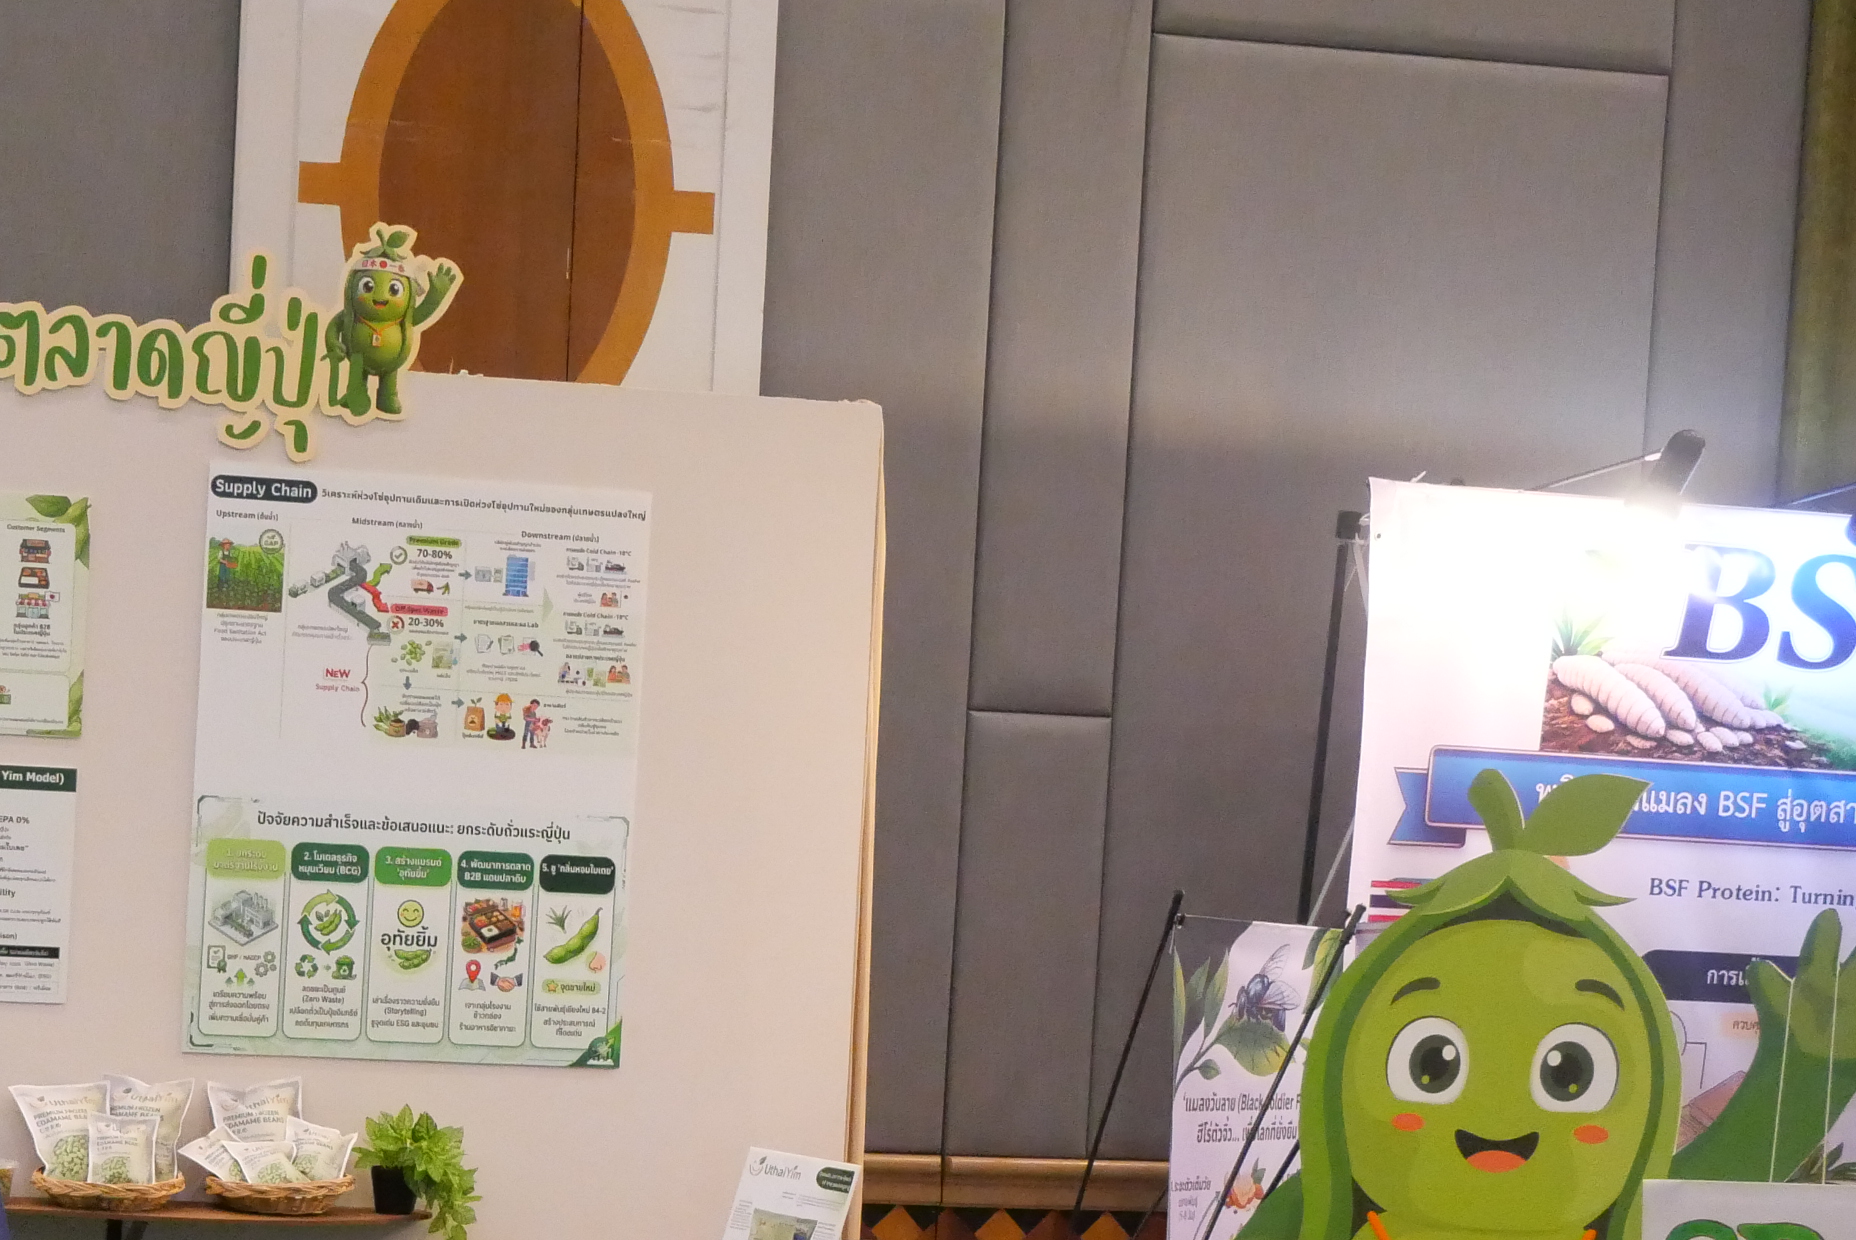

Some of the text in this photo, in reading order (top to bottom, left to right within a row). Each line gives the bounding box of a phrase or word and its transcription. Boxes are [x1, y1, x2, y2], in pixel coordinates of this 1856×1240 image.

[215, 479, 266, 498] Supply
[271, 482, 312, 499] Chain
[216, 509, 256, 520] Upstream
[351, 517, 394, 528] Midstream
[521, 530, 571, 542] Downstream
[416, 548, 453, 560] 70-80%
[408, 617, 444, 628] 20-30%
[325, 668, 351, 679] NEW
[315, 683, 360, 693] Supply Chain
[1, 769, 23, 782] Yim
[26, 771, 65, 785] Model)
[1718, 791, 1768, 819] BSF
[16, 815, 30, 825] 0%
[257, 810, 571, 844] ปัจจัยความสำเร็จและข้อเสนอแนะ: ยกระดับถั่วแระญี่ปุ่น
[313, 850, 358, 863] โมเดลธุรกิจ
[336, 865, 361, 876] (BCG)
[464, 871, 481, 881] B2B
[1649, 877, 1689, 898] BSF
[1697, 880, 1781, 902] Protein:
[380, 925, 438, 952] อุทัยยิ้ม
[1266, 1093, 1294, 1111] oldier
